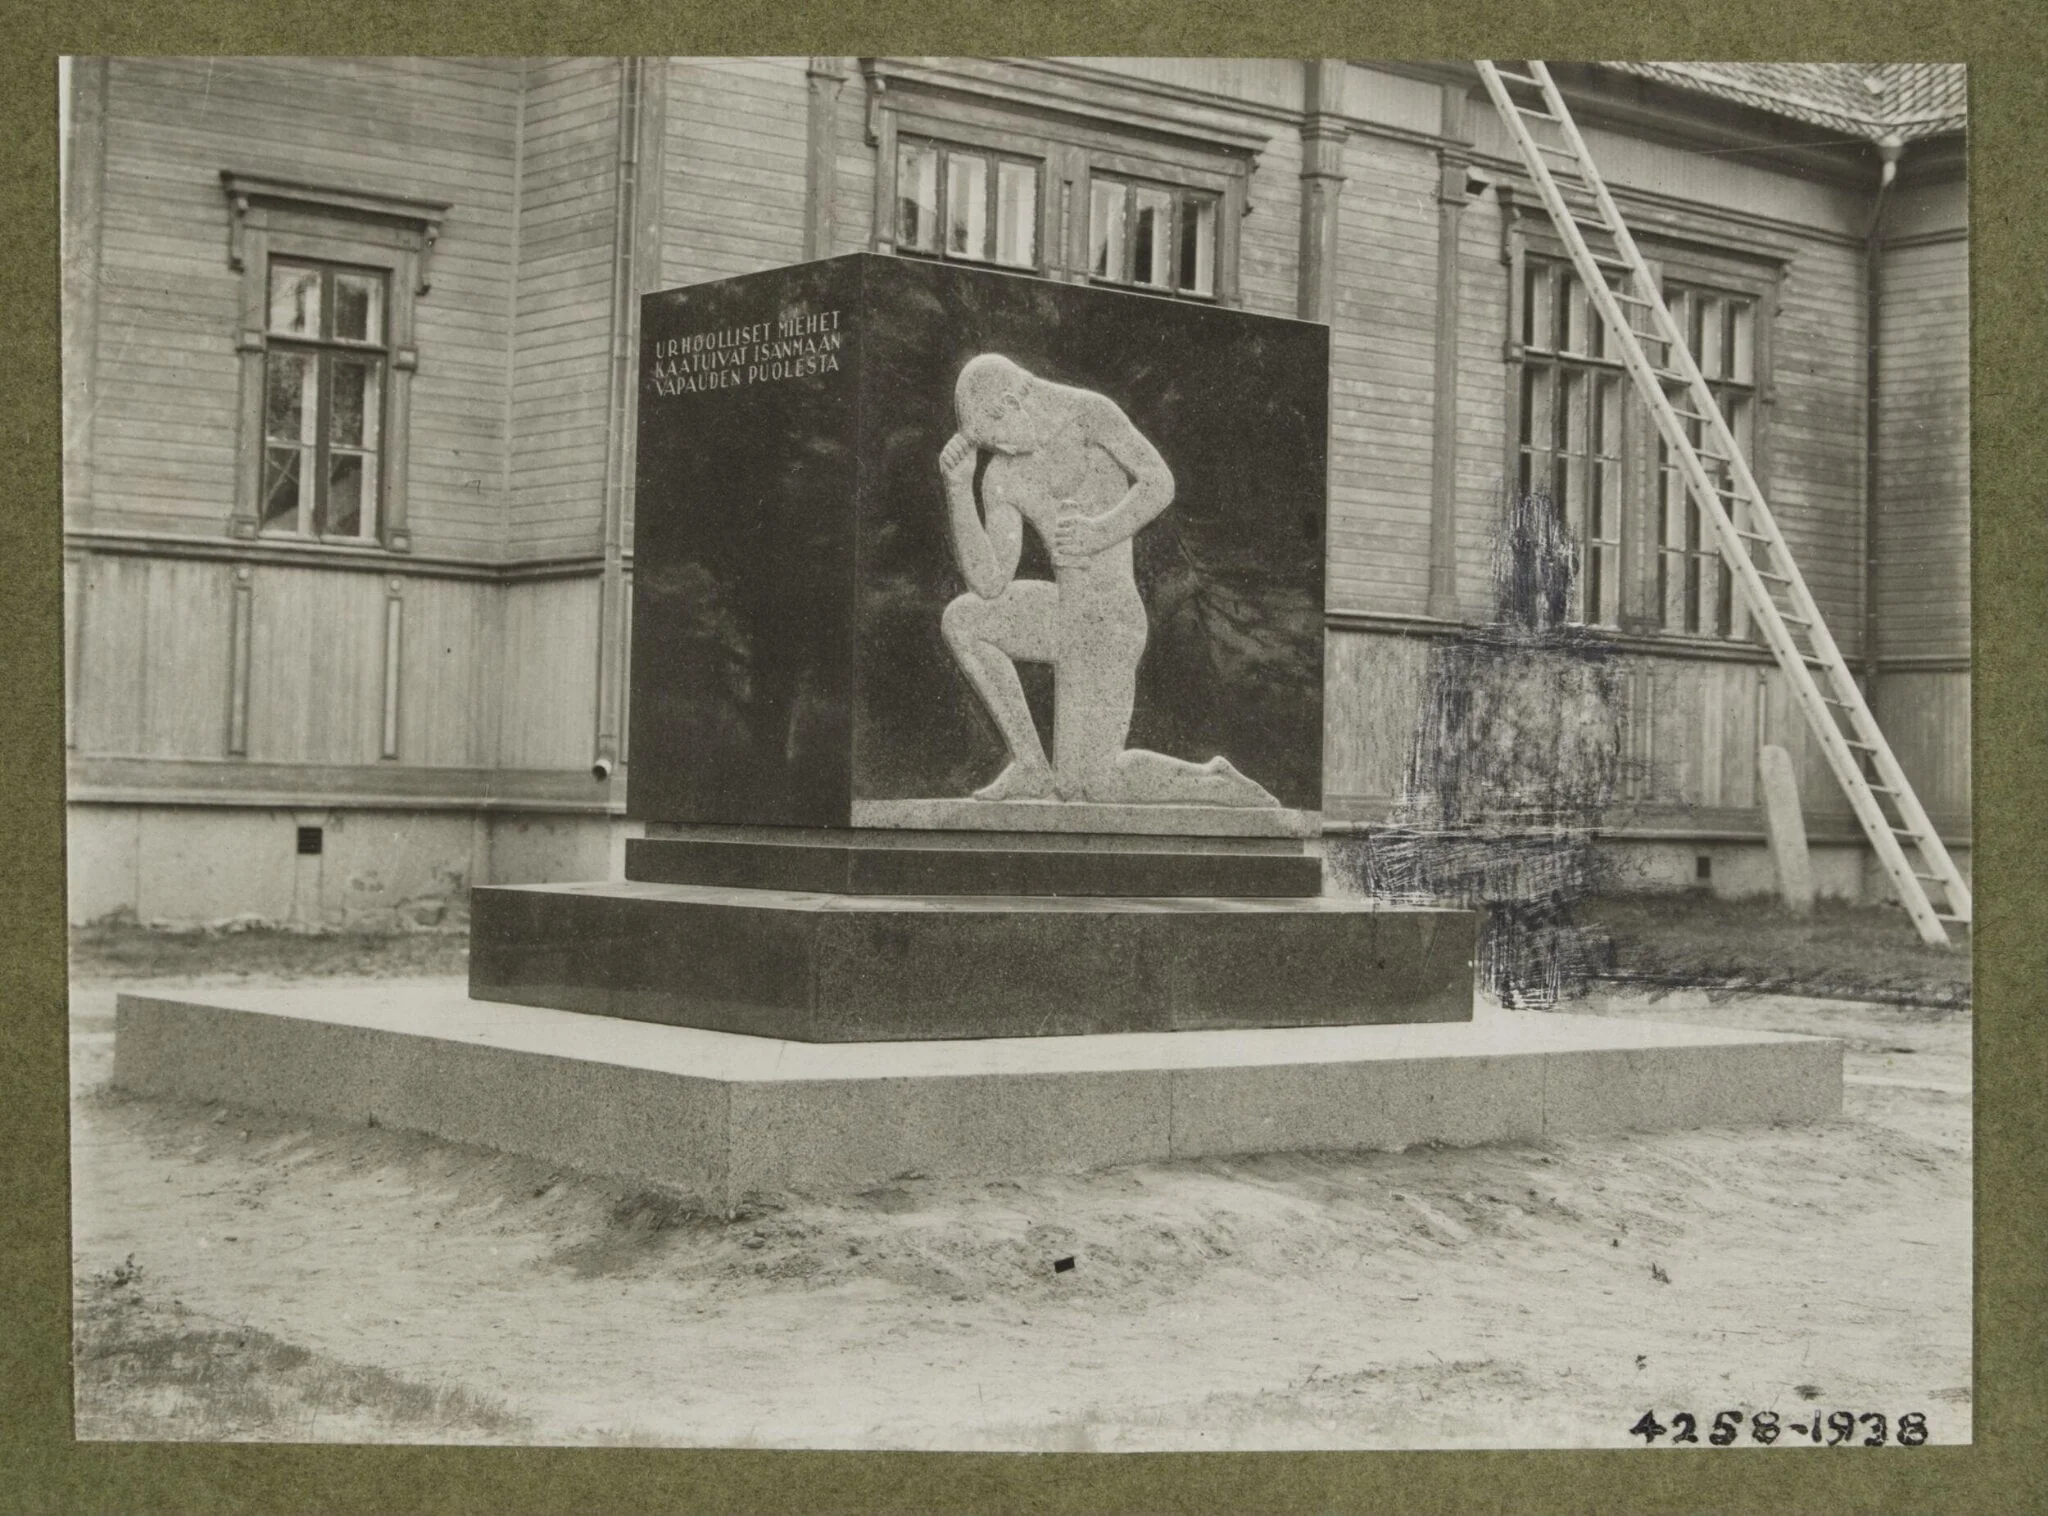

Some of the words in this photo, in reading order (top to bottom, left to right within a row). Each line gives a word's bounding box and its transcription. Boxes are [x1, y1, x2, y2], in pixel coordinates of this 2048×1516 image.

[656, 323, 771, 359] URHOOLLISET
[778, 311, 841, 337] MIEHET
[656, 346, 748, 378] KAATUIVAT
[656, 369, 741, 396] VAPAUDEN
[749, 354, 840, 384] PUOLESTA
